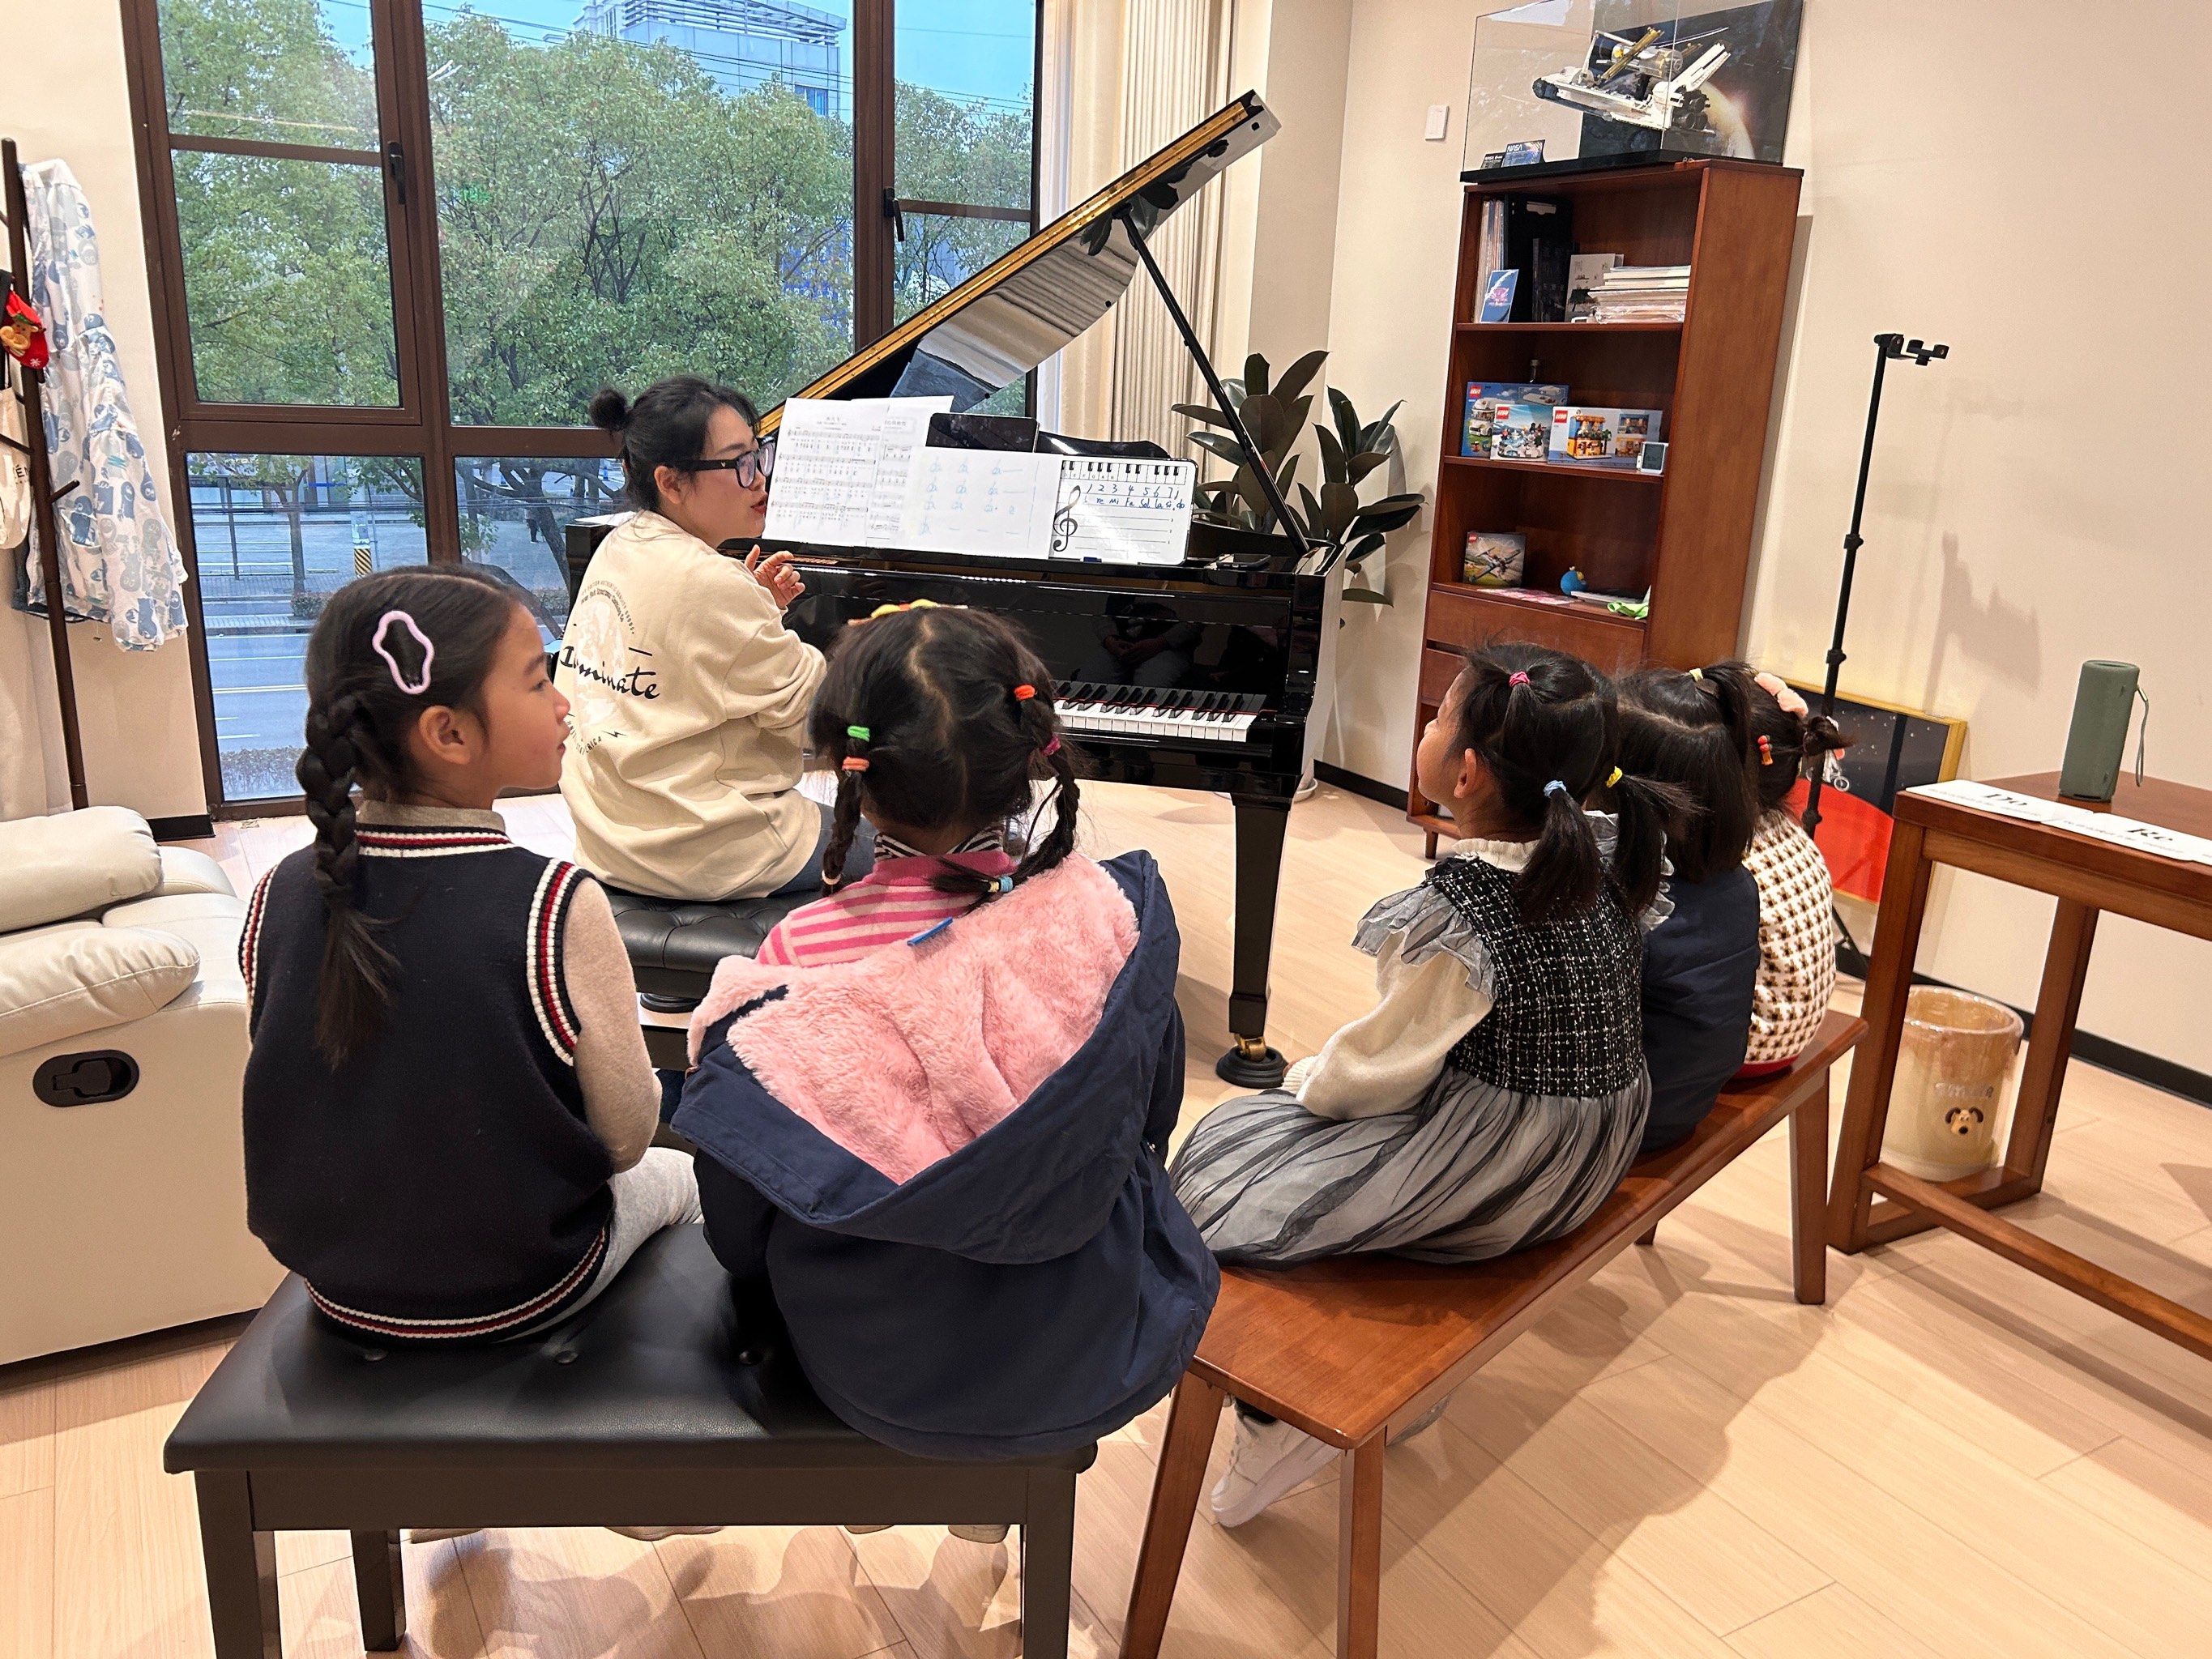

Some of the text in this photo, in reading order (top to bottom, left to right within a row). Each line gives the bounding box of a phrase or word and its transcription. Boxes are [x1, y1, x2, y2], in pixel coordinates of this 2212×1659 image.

[1086, 484, 1093, 494] 1
[1098, 484, 1105, 492] 2
[1112, 484, 1119, 493] 3
[1128, 484, 1134, 497] 4
[1142, 487, 1151, 496] 5
[1153, 486, 1160, 497] 6
[1168, 487, 1173, 498] 7
[1176, 499, 1185, 510] do
